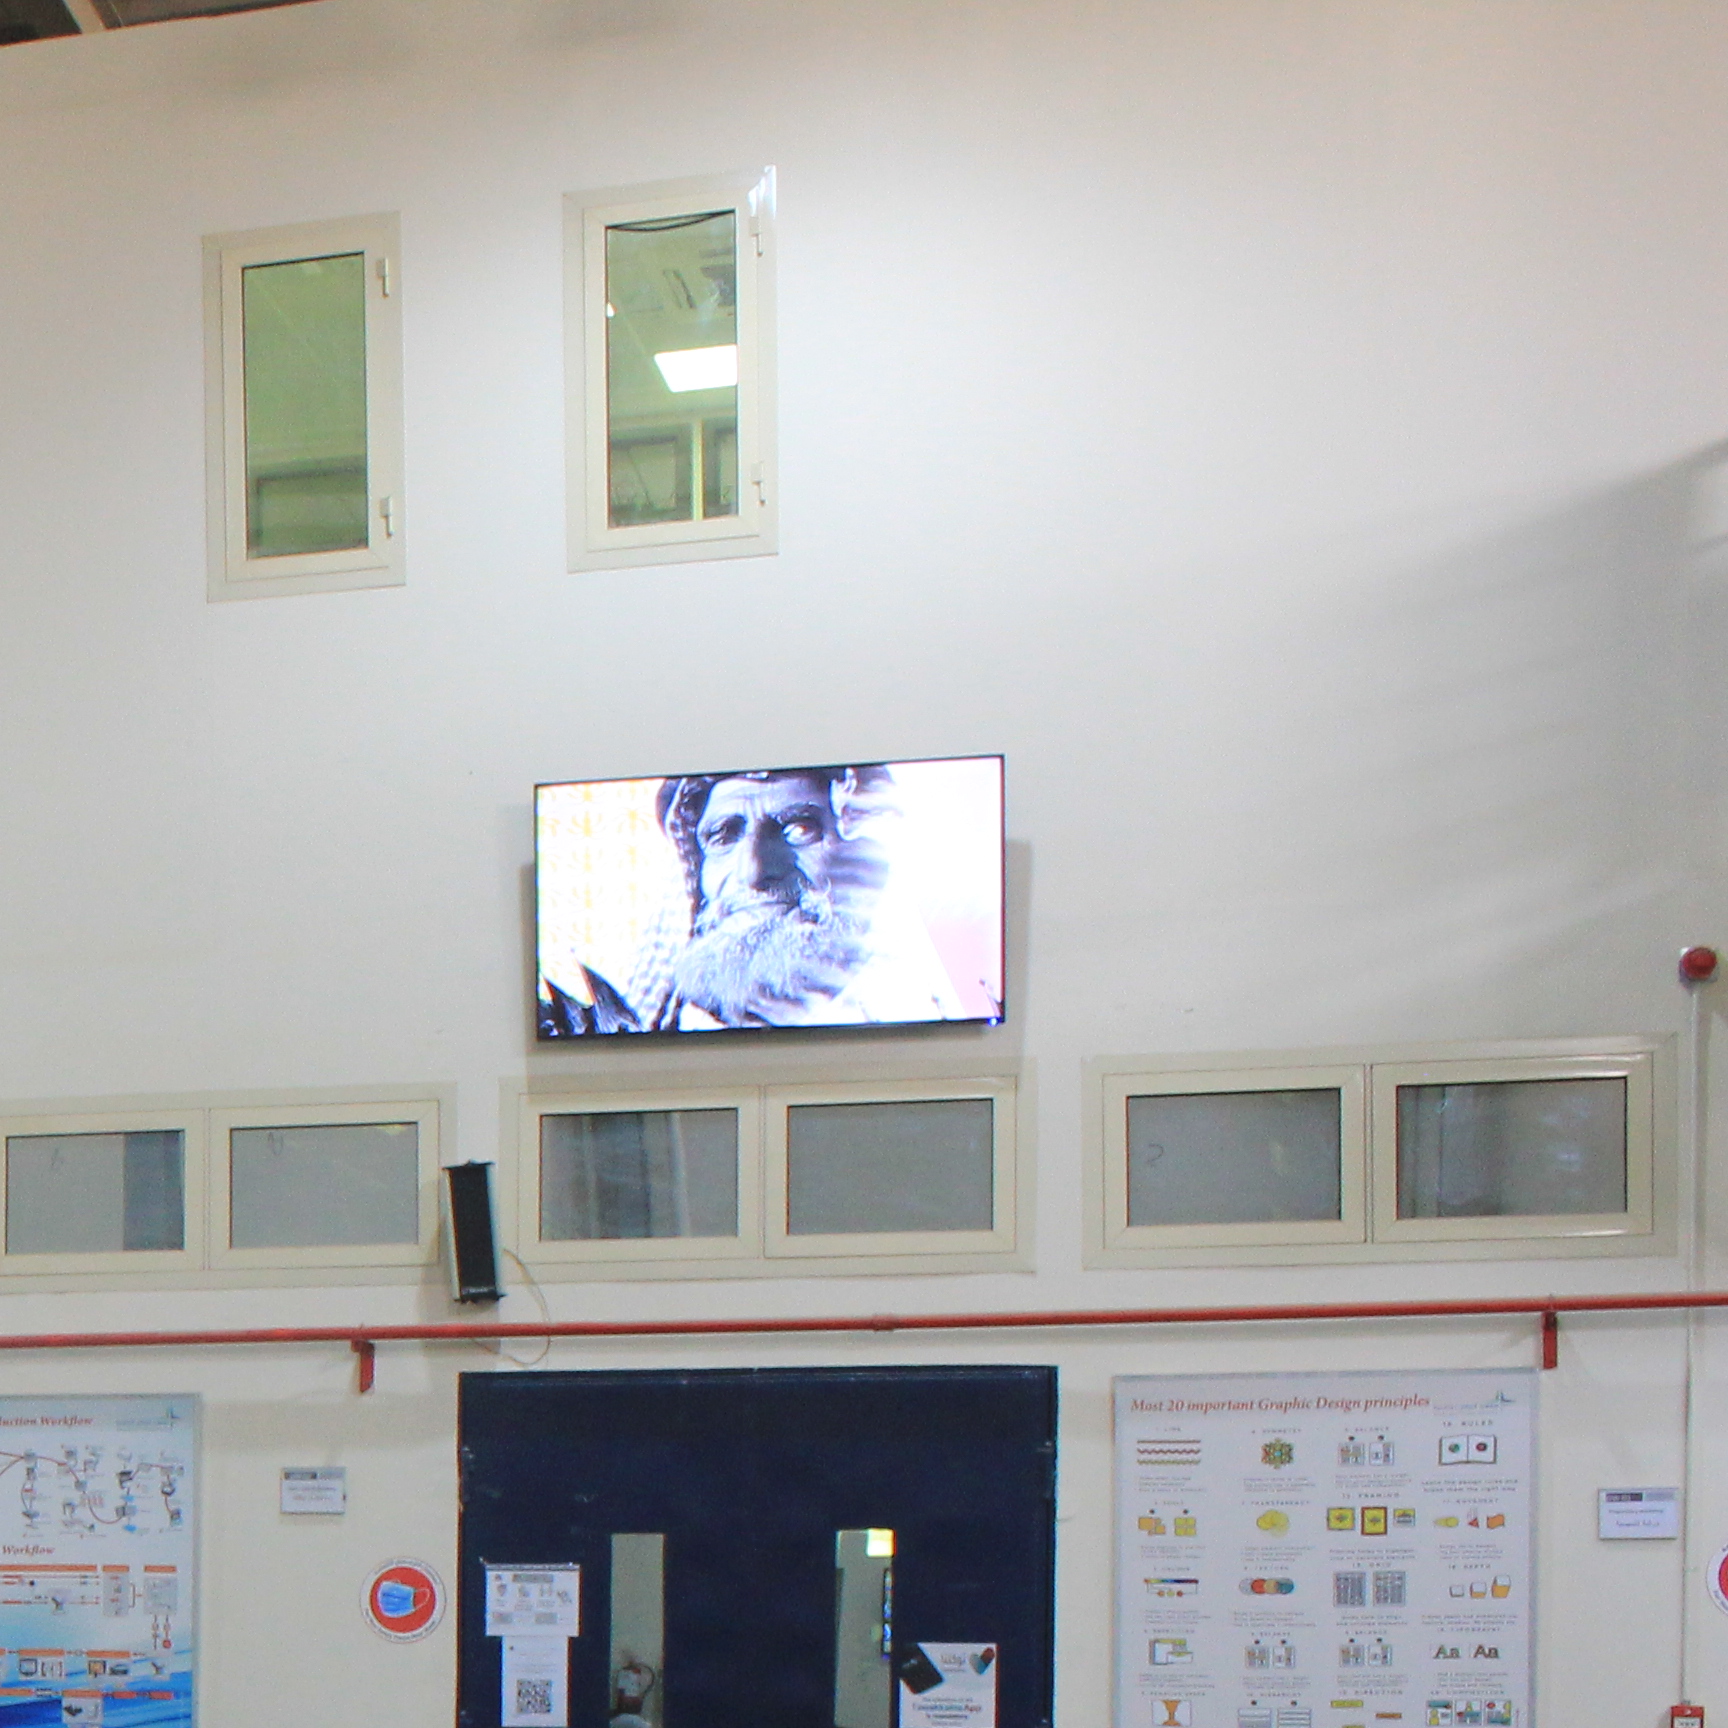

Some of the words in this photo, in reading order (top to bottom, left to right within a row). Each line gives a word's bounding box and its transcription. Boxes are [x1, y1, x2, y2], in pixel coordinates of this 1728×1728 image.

[1131, 1399, 1163, 1412] Most
[1167, 1399, 1184, 1411] 20
[1187, 1398, 1254, 1418] important
[1258, 1397, 1311, 1415] Graphic
[1316, 1396, 1360, 1412] Design
[1363, 1394, 1430, 1412] principles
[40, 1415, 93, 1429] Workflow
[2, 1543, 56, 1557] Workflow
[1473, 1643, 1500, 1660] Aa
